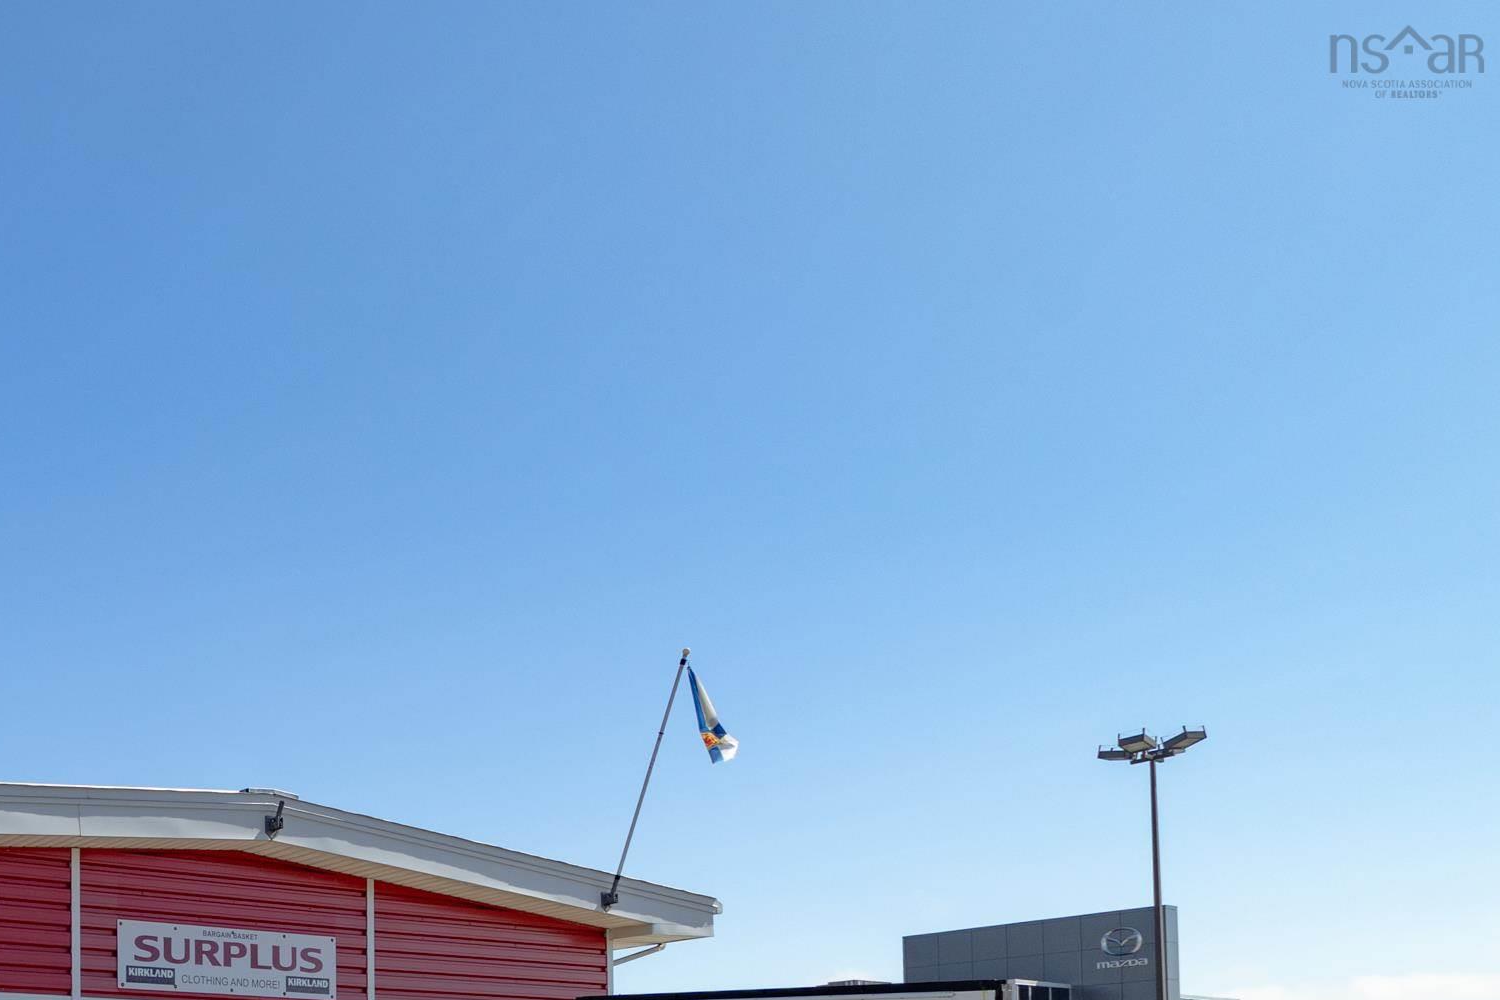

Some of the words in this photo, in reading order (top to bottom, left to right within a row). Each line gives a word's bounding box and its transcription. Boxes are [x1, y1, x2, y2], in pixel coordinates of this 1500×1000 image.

[202, 929, 232, 939] BARGAIN
[233, 932, 258, 941] BASKET
[133, 934, 324, 974] SURPLUS
[128, 967, 174, 979] KIRKLAND
[181, 974, 229, 986] CLOTHING
[230, 977, 250, 988] AND
[251, 979, 280, 990] MORE!
[287, 977, 329, 988] KIRKLAND
